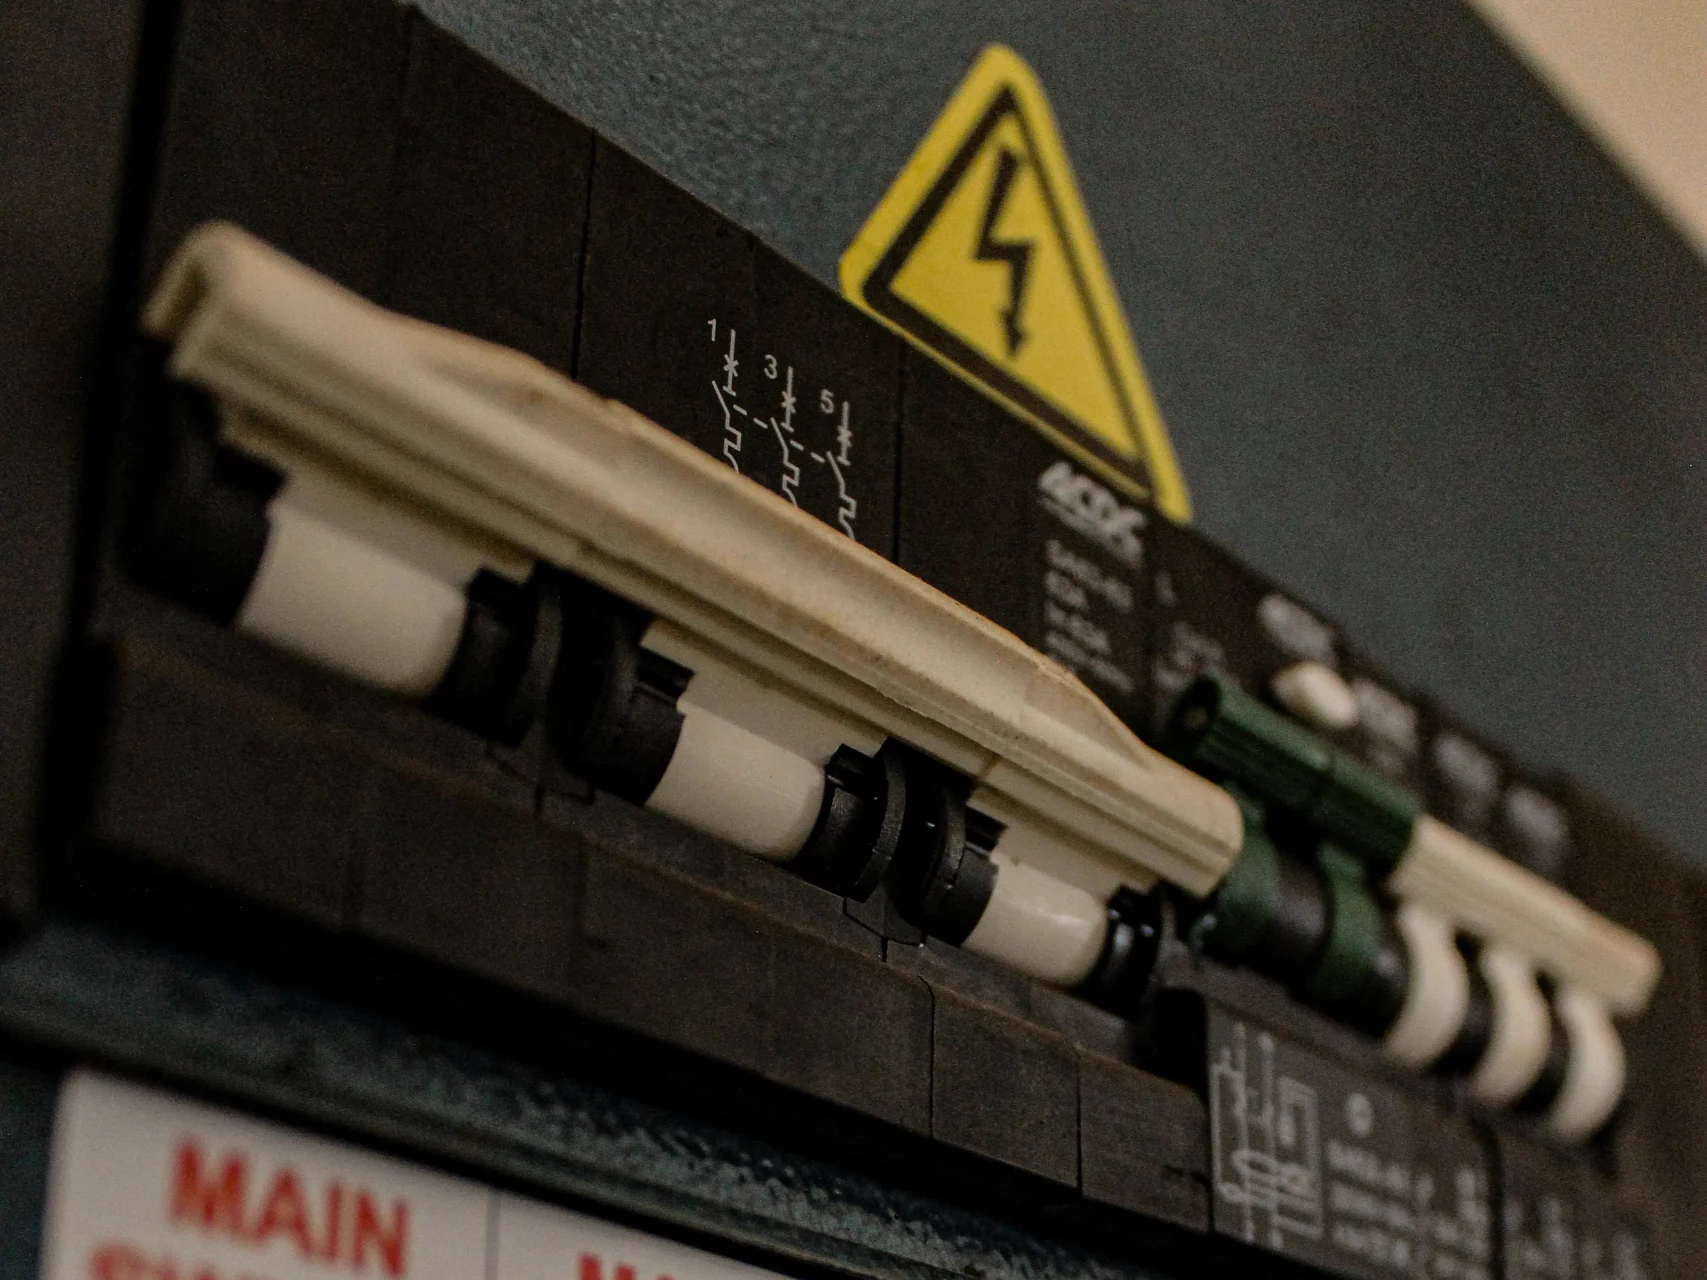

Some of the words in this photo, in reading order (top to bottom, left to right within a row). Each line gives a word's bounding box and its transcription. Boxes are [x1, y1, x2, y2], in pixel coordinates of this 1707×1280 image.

[707, 318, 717, 342] 1
[764, 353, 778, 380] 3
[820, 388, 835, 415] 5
